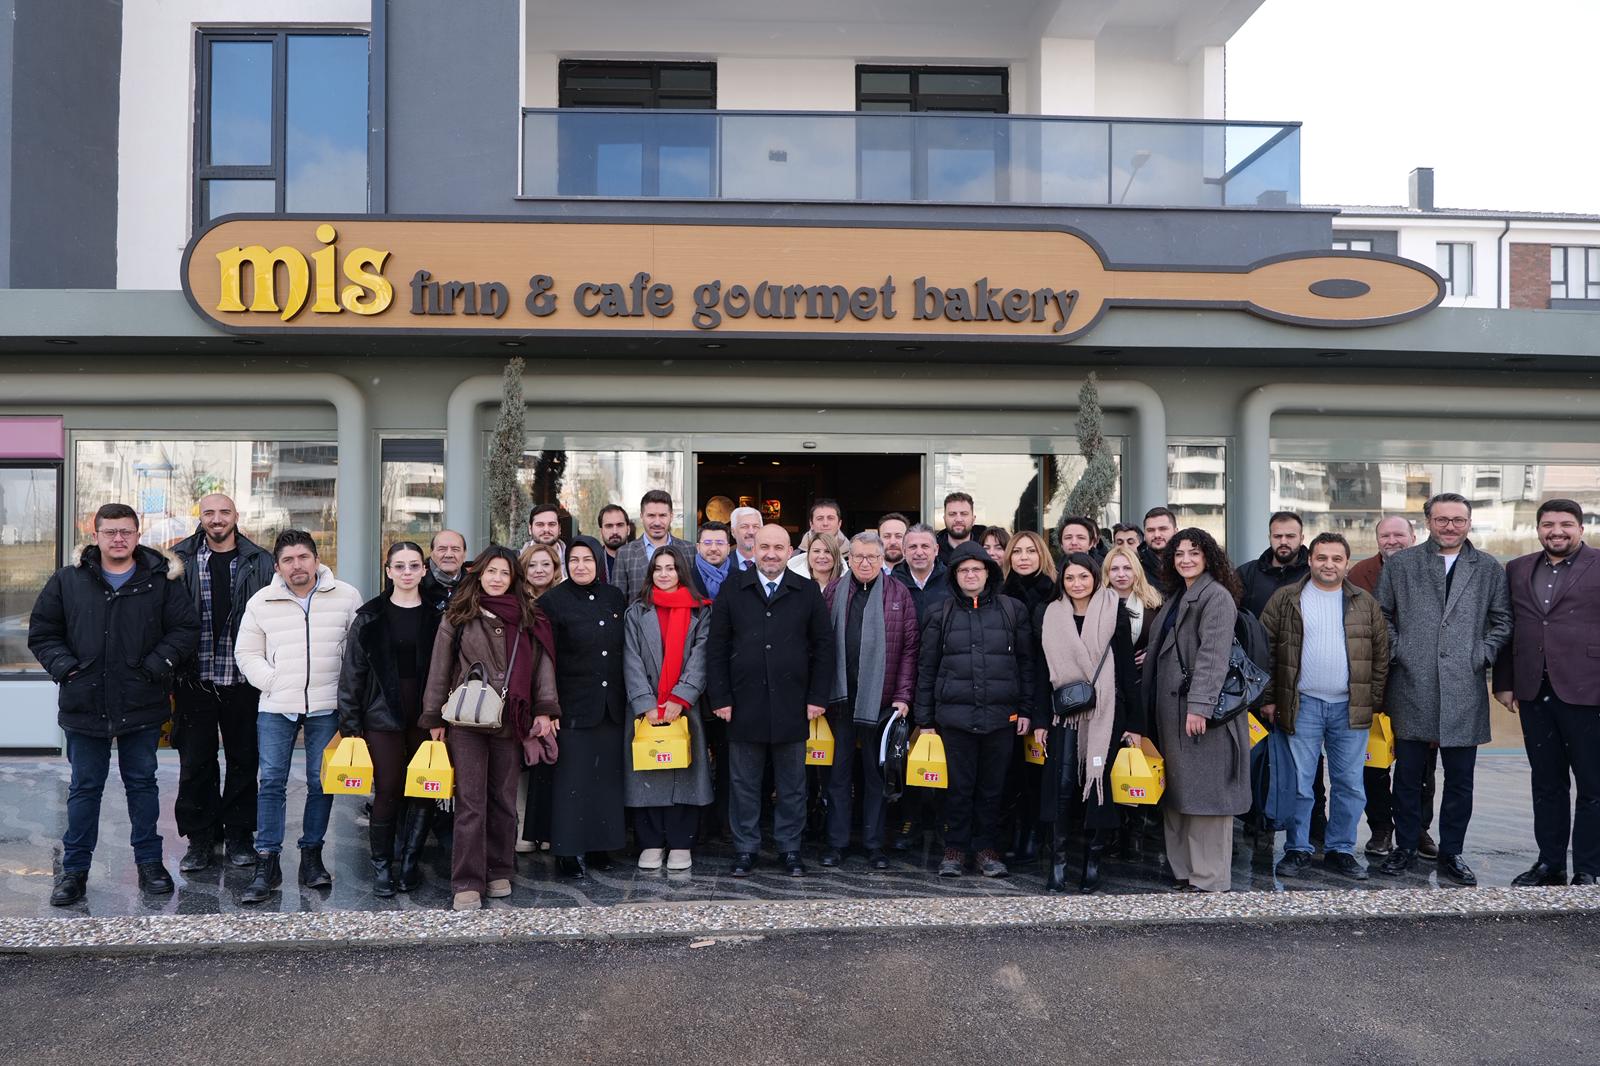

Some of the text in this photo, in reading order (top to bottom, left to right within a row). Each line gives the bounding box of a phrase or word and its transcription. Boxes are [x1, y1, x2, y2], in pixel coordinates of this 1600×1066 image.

[215, 223, 394, 321] mis
[525, 274, 558, 317] &
[573, 271, 675, 318] cafe
[692, 274, 898, 330] gourmet
[912, 276, 1080, 332] bakery
